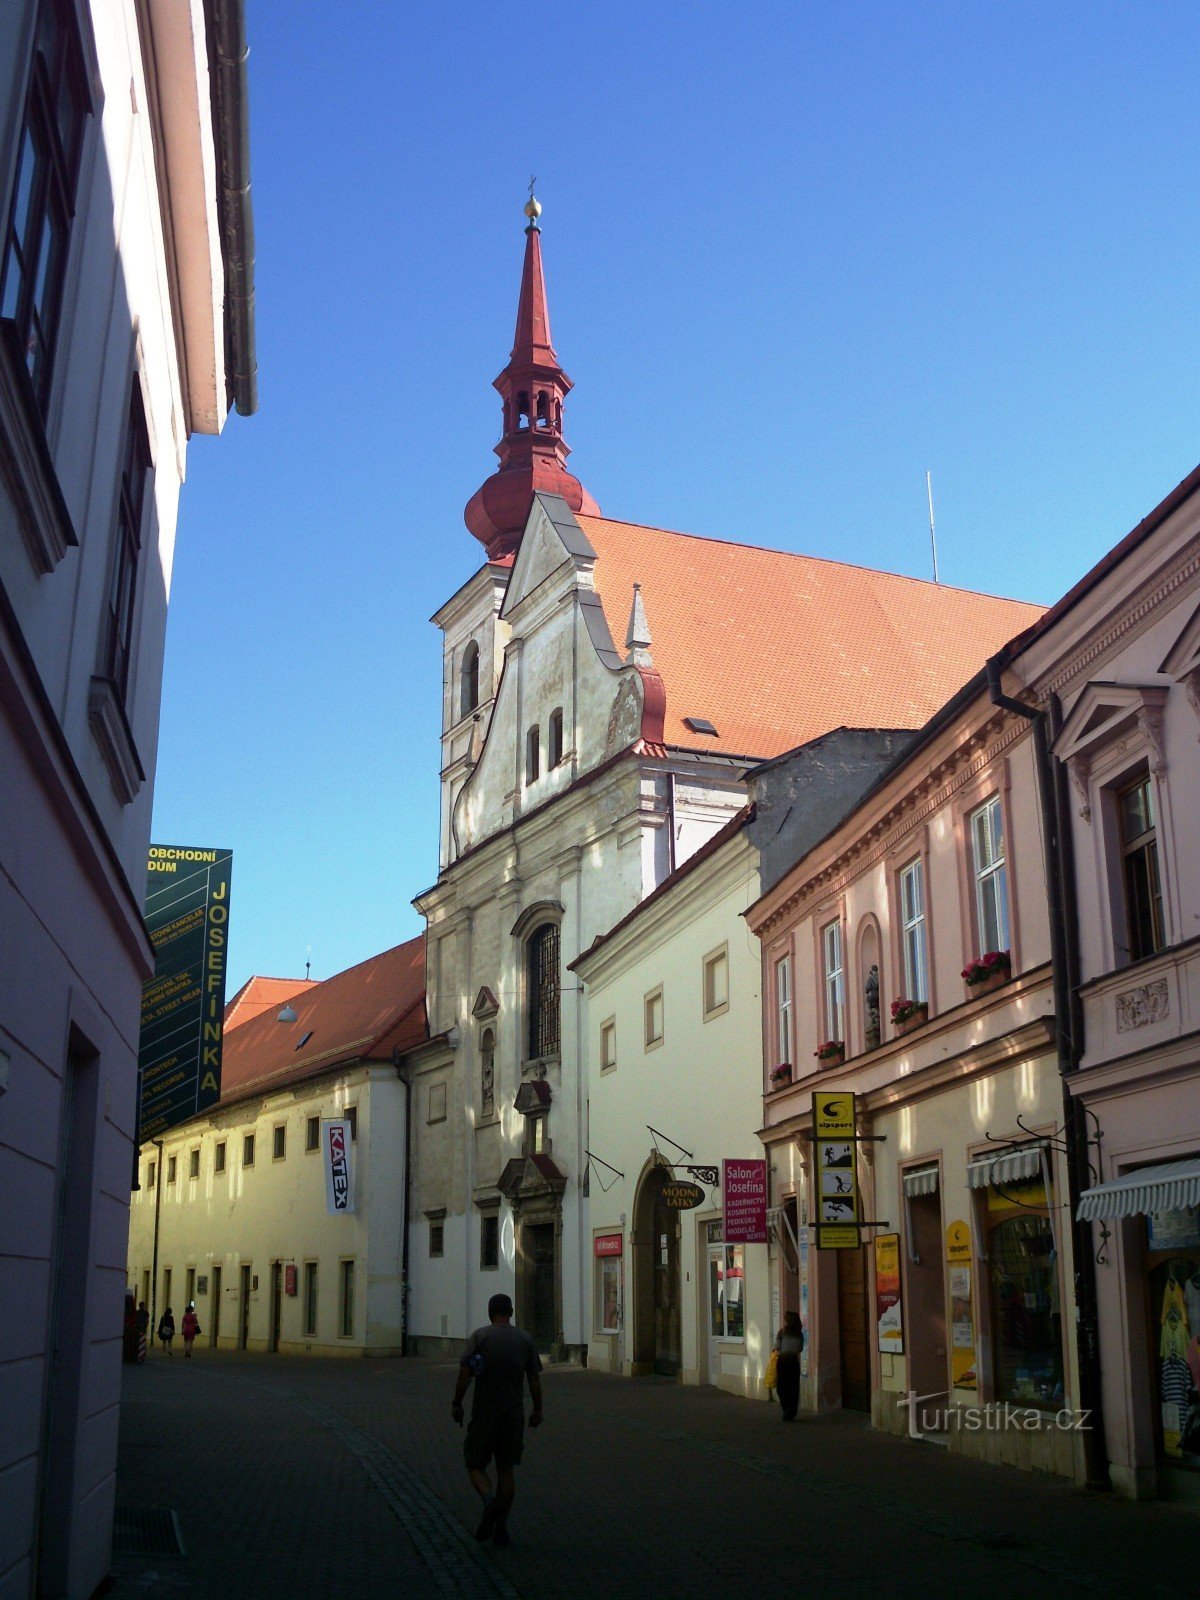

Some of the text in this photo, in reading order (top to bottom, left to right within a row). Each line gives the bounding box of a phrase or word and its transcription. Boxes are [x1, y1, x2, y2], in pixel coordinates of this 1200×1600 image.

[148, 848, 217, 862] OBCHODNÍ
[147, 859, 177, 872] DŮM
[200, 881, 227, 1091] JOSEFÍNKA
[331, 1127, 348, 1208] KATEX
[727, 1166, 752, 1179] Salon
[727, 1208, 761, 1216] KOSMETIKA
